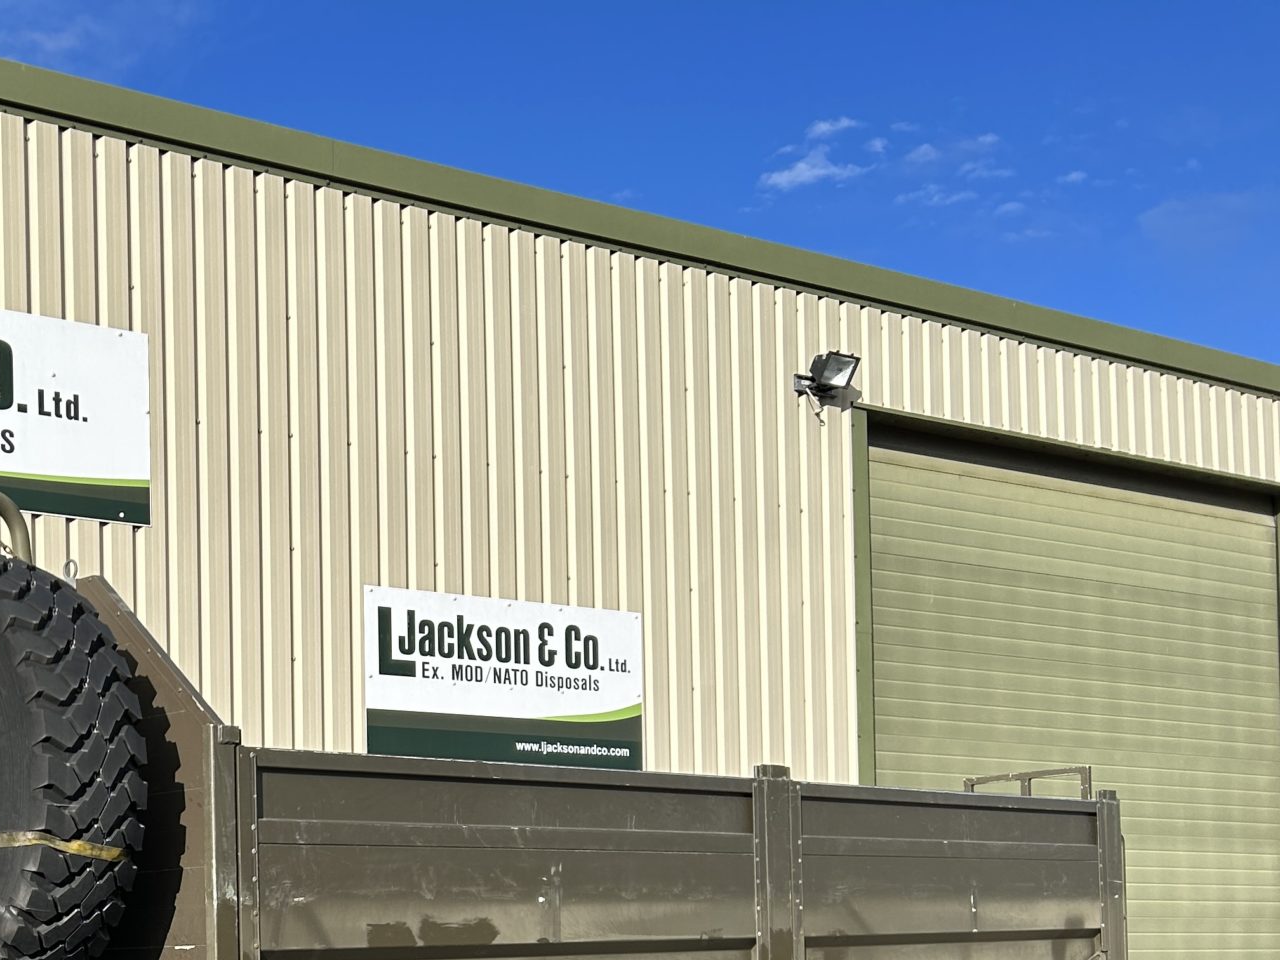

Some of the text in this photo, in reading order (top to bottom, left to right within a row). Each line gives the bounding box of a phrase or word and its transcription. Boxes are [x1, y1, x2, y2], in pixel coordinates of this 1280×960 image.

[37, 388, 88, 423] Ltd.
[538, 622, 558, 667] &
[564, 624, 605, 671] Co.
[608, 657, 631, 674] Ltd.
[421, 662, 600, 692] Ex. MOD/NATO Disposals
[515, 740, 630, 758] www.ljacksonandco.com
